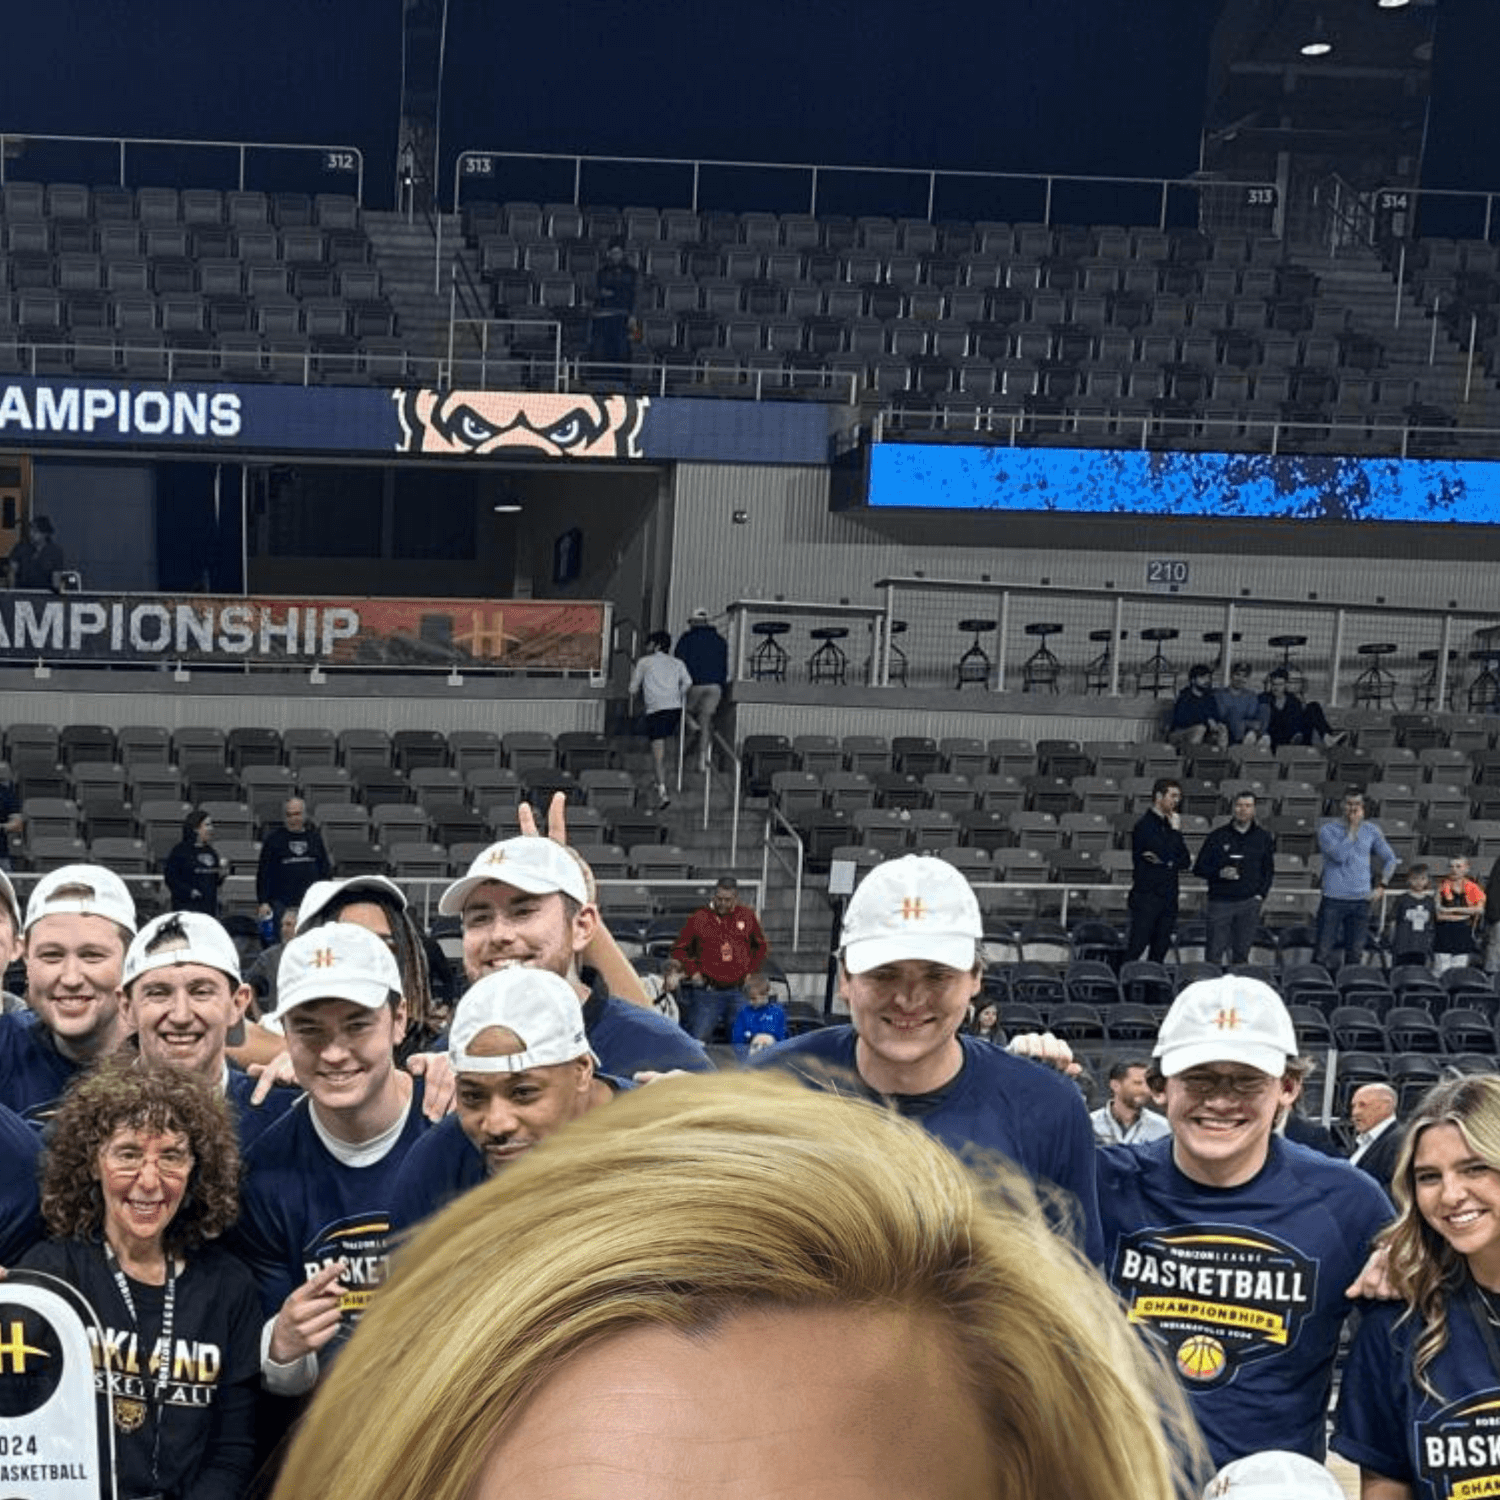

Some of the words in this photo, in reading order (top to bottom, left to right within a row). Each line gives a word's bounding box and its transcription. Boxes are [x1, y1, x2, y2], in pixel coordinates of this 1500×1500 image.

[328, 154, 353, 169] 312
[466, 158, 491, 172] 313
[1248, 189, 1272, 203] 313
[1381, 194, 1407, 208] 314
[1149, 560, 1187, 582] 210
[1121, 1248, 1307, 1303] BASKETBALL
[1143, 1300, 1275, 1328] CHAMPIONSHIPS
